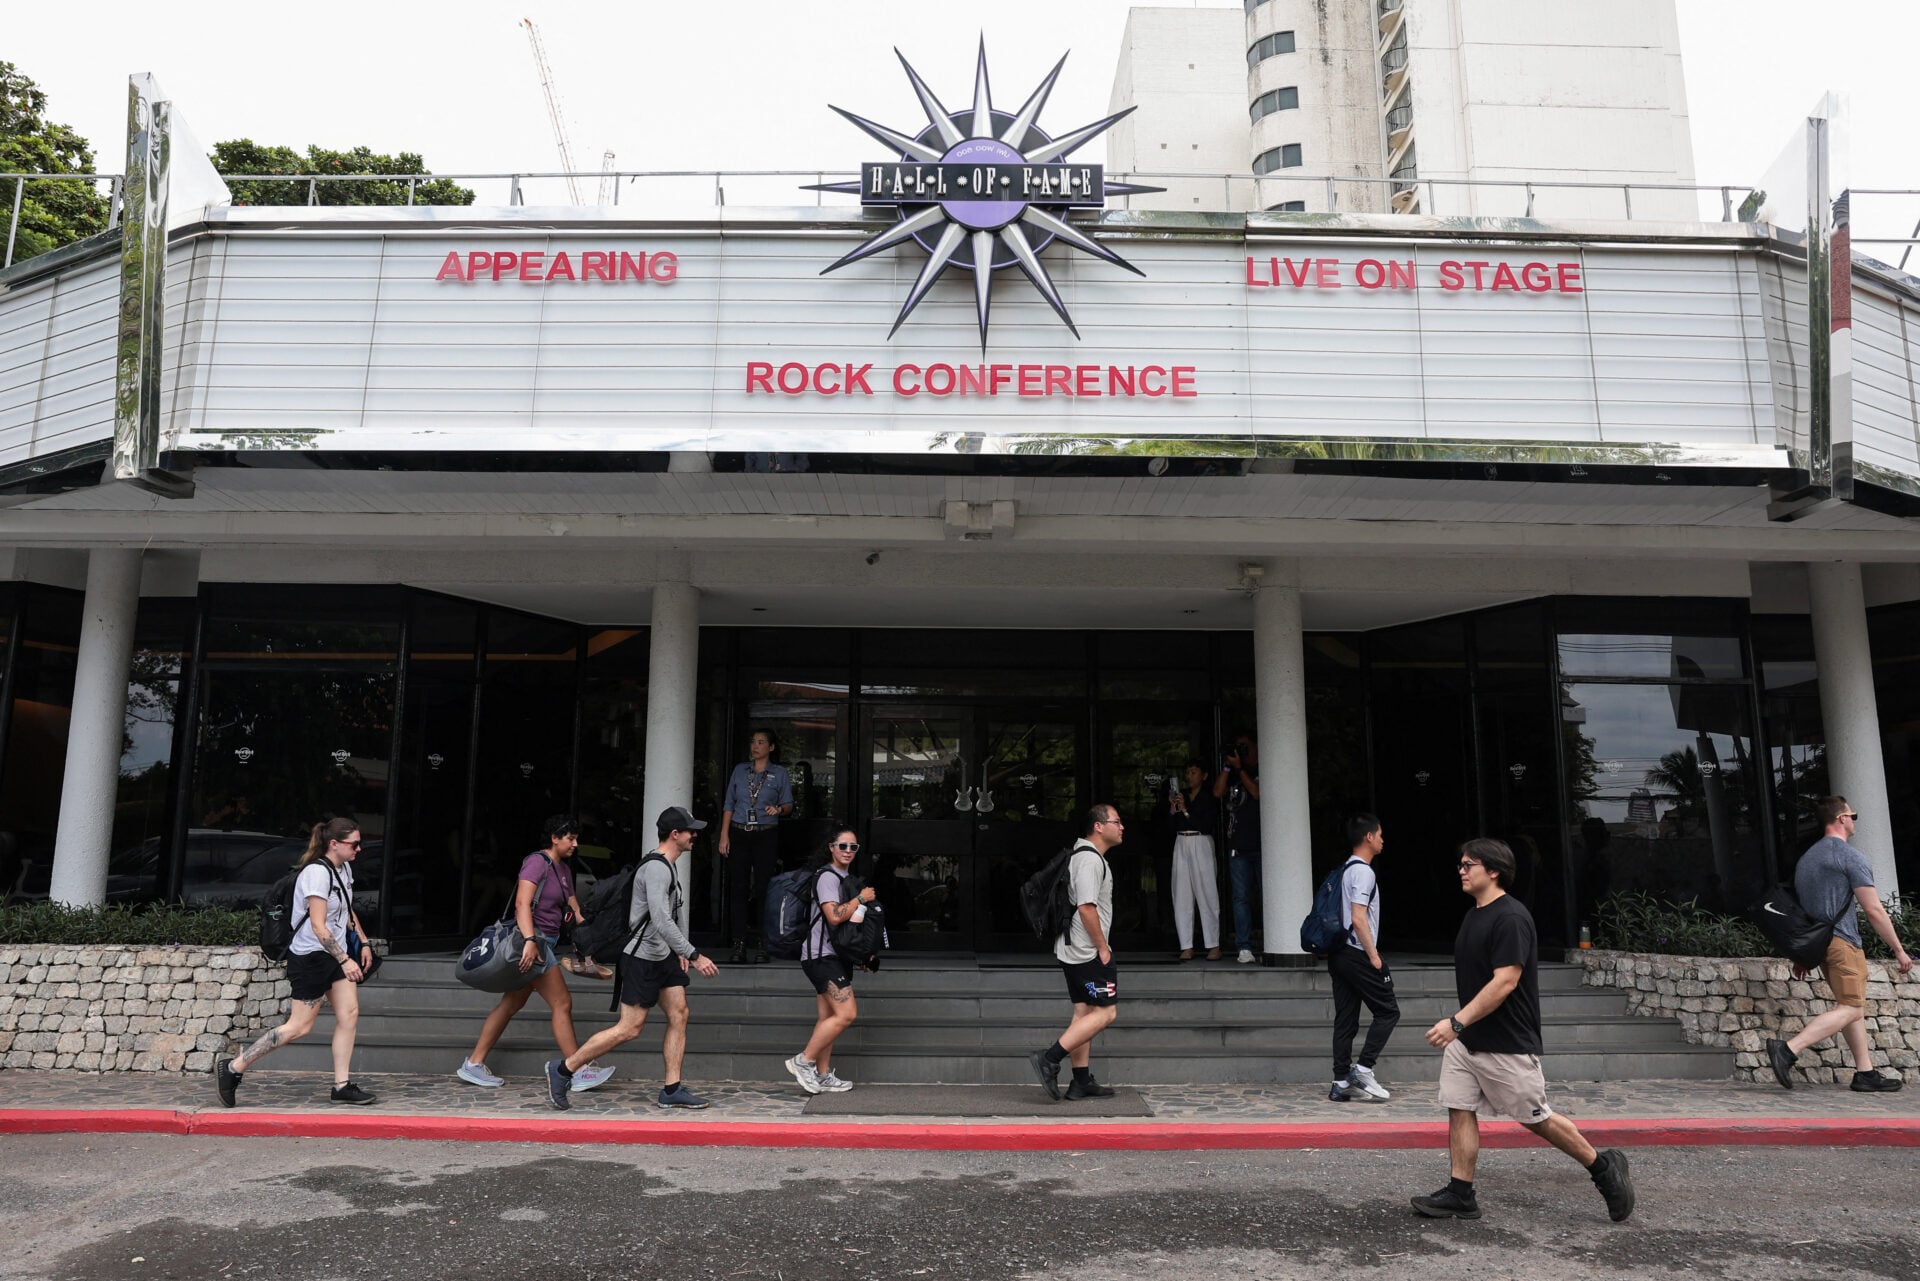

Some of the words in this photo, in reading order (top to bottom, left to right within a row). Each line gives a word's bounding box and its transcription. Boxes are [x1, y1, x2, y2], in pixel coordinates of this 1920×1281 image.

[871, 166, 947, 195] HALL
[972, 166, 996, 195] OF
[1022, 166, 1092, 197] FAME
[436, 251, 678, 283] APPEARING
[1246, 256, 1341, 288] LIVE
[1354, 258, 1417, 290] ON
[1439, 260, 1584, 293] STAGE
[745, 361, 874, 396] ROCK
[892, 362, 1198, 397] CONFERENCE
